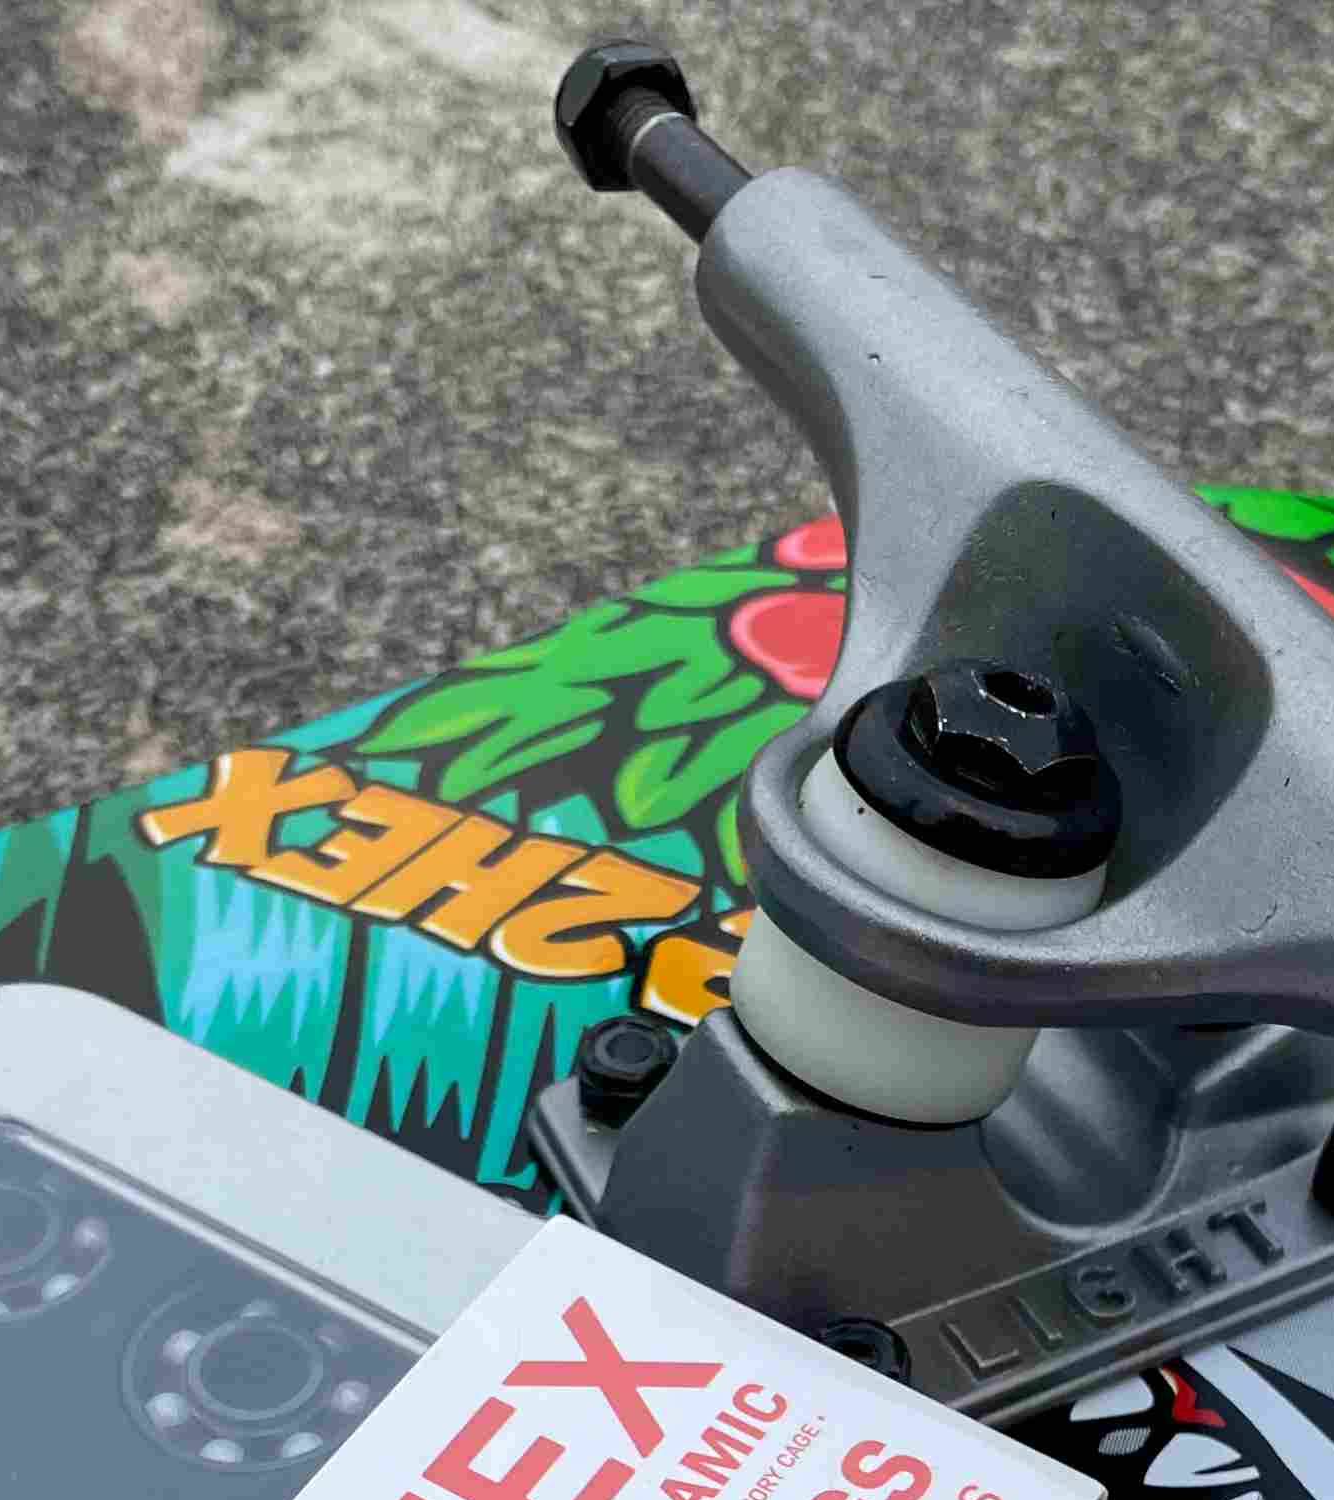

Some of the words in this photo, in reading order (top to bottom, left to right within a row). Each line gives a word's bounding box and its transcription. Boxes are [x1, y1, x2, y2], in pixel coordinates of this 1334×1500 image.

[139, 746, 702, 980] 2HEX
[937, 1199, 1286, 1380] LIGHT
[776, 1424, 821, 1468] CAGE
